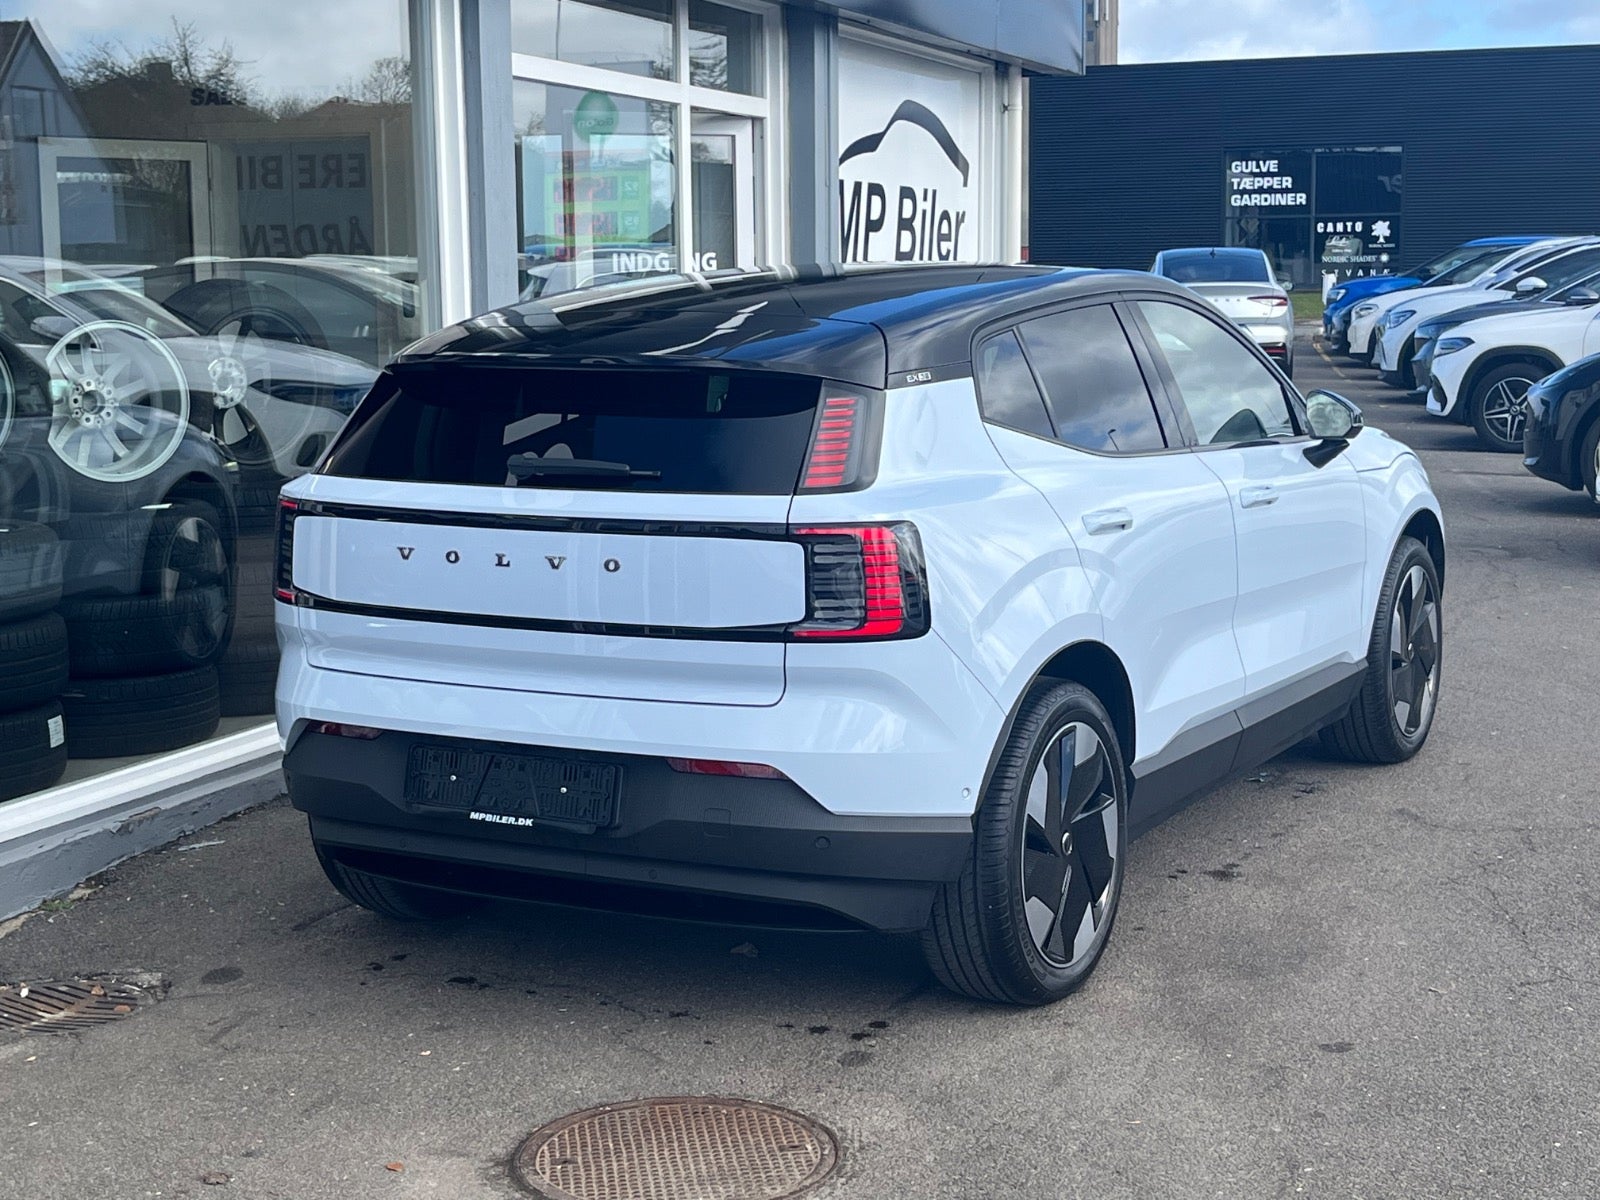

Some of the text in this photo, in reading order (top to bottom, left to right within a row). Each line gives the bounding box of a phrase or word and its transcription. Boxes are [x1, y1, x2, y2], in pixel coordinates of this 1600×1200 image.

[1231, 160, 1279, 173] GULVE
[1231, 176, 1293, 190] TÆPPER
[1230, 193, 1307, 206] GARDINER
[838, 179, 966, 263] MP Biler
[1316, 221, 1363, 233] CANTO
[612, 252, 718, 274] INDGNG
[396, 546, 621, 573] VOLVO
[469, 811, 534, 827] MPBILER.DK
